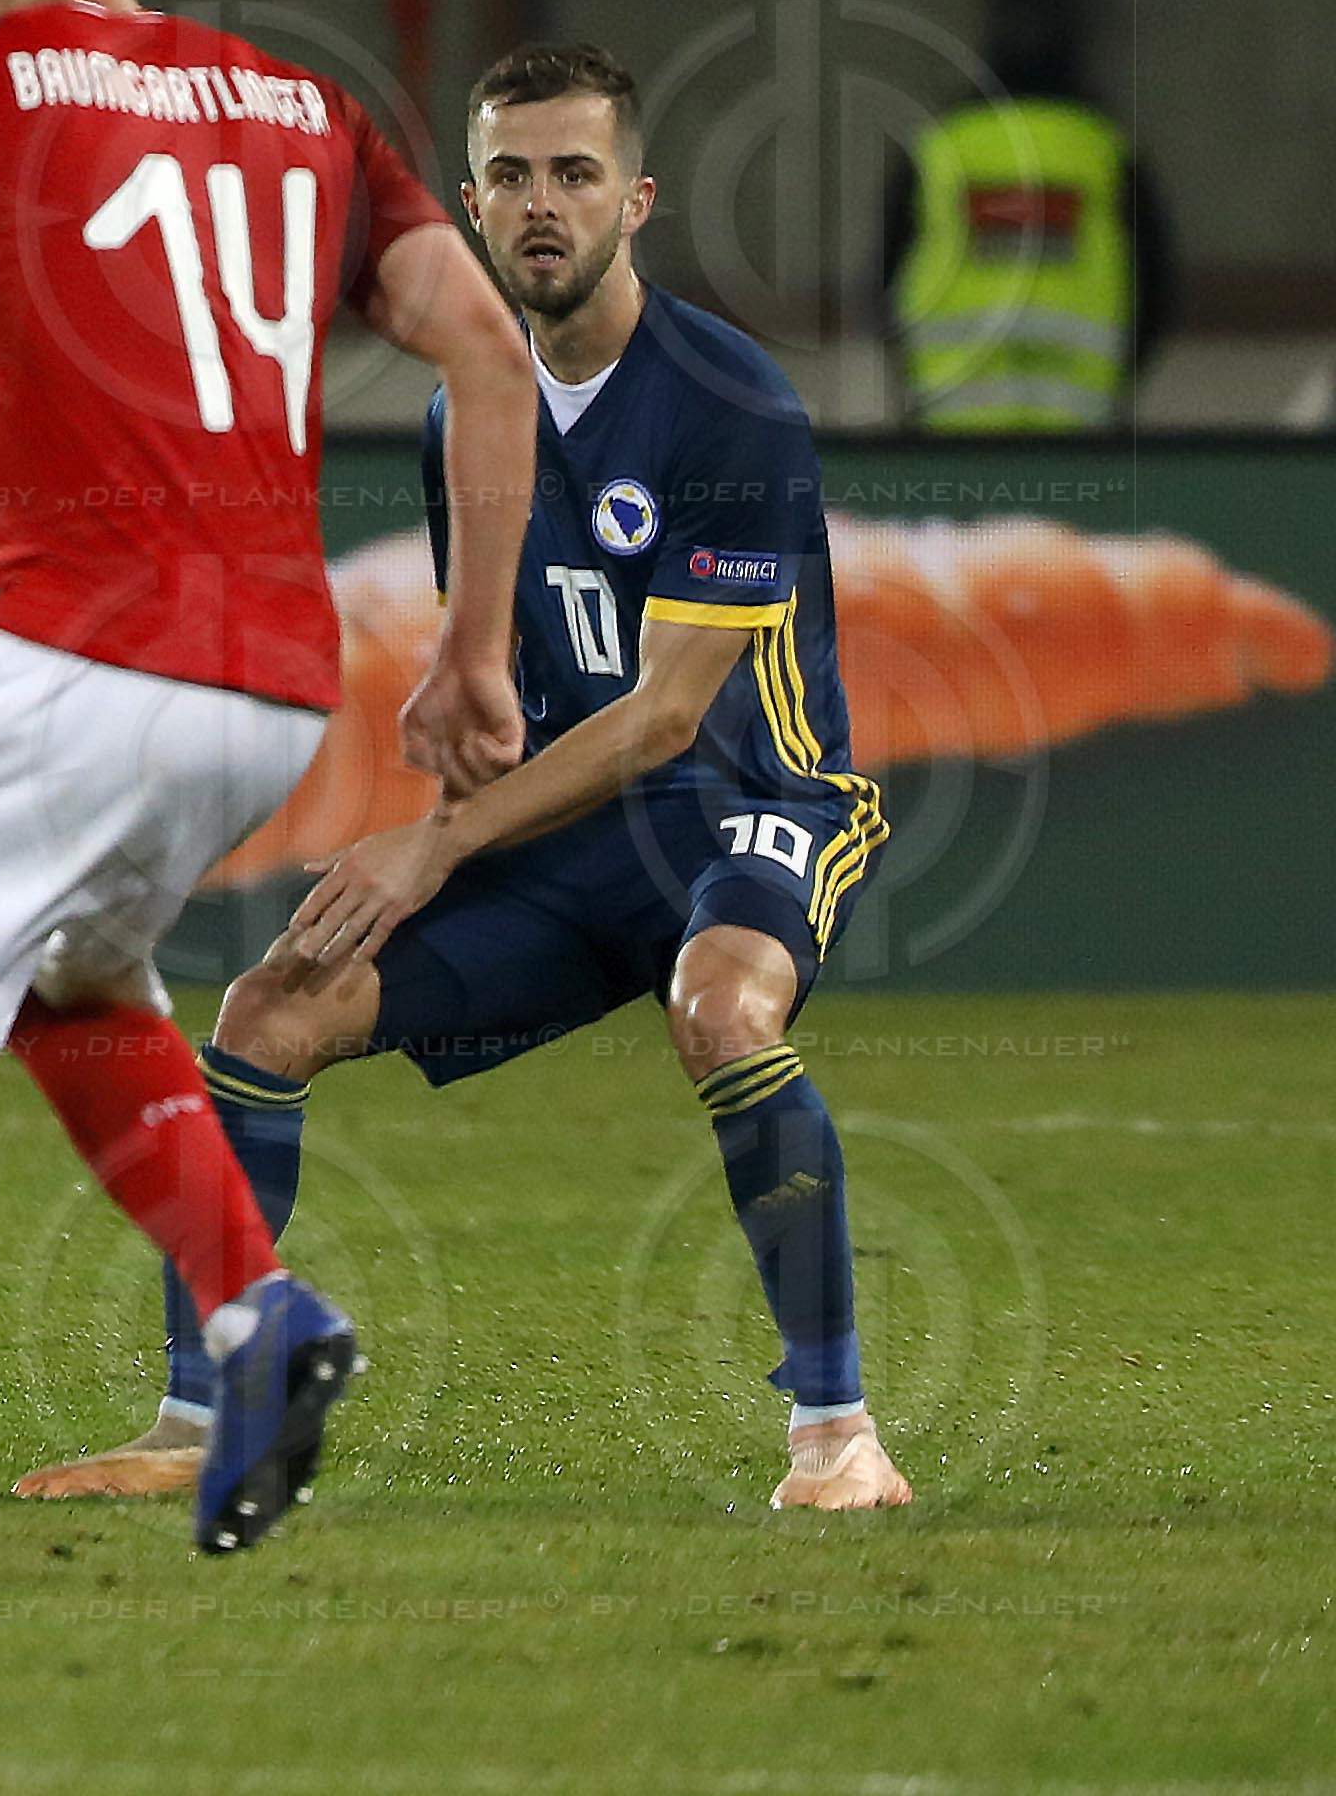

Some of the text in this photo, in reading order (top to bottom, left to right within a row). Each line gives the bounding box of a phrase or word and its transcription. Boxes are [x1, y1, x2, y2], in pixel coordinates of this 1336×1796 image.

[83, 153, 317, 457] 14
[545, 565, 625, 678] 10
[719, 813, 814, 879] 10
